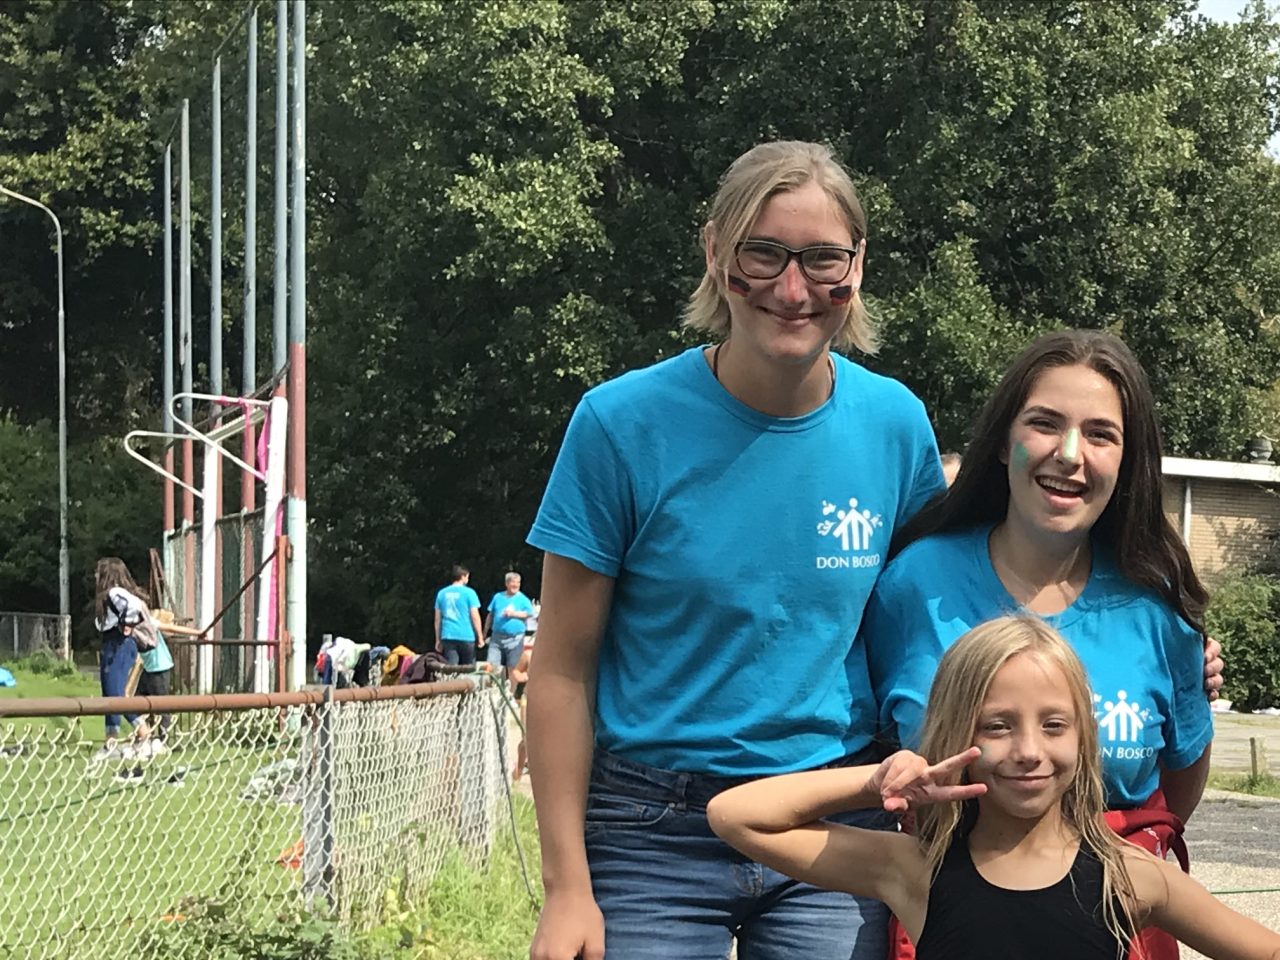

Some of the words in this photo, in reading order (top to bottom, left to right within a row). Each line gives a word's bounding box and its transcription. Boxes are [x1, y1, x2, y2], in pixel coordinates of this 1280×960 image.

[816, 556, 849, 569] DON
[852, 553, 880, 568] BOSCO
[1116, 746, 1154, 760] BOSCO
